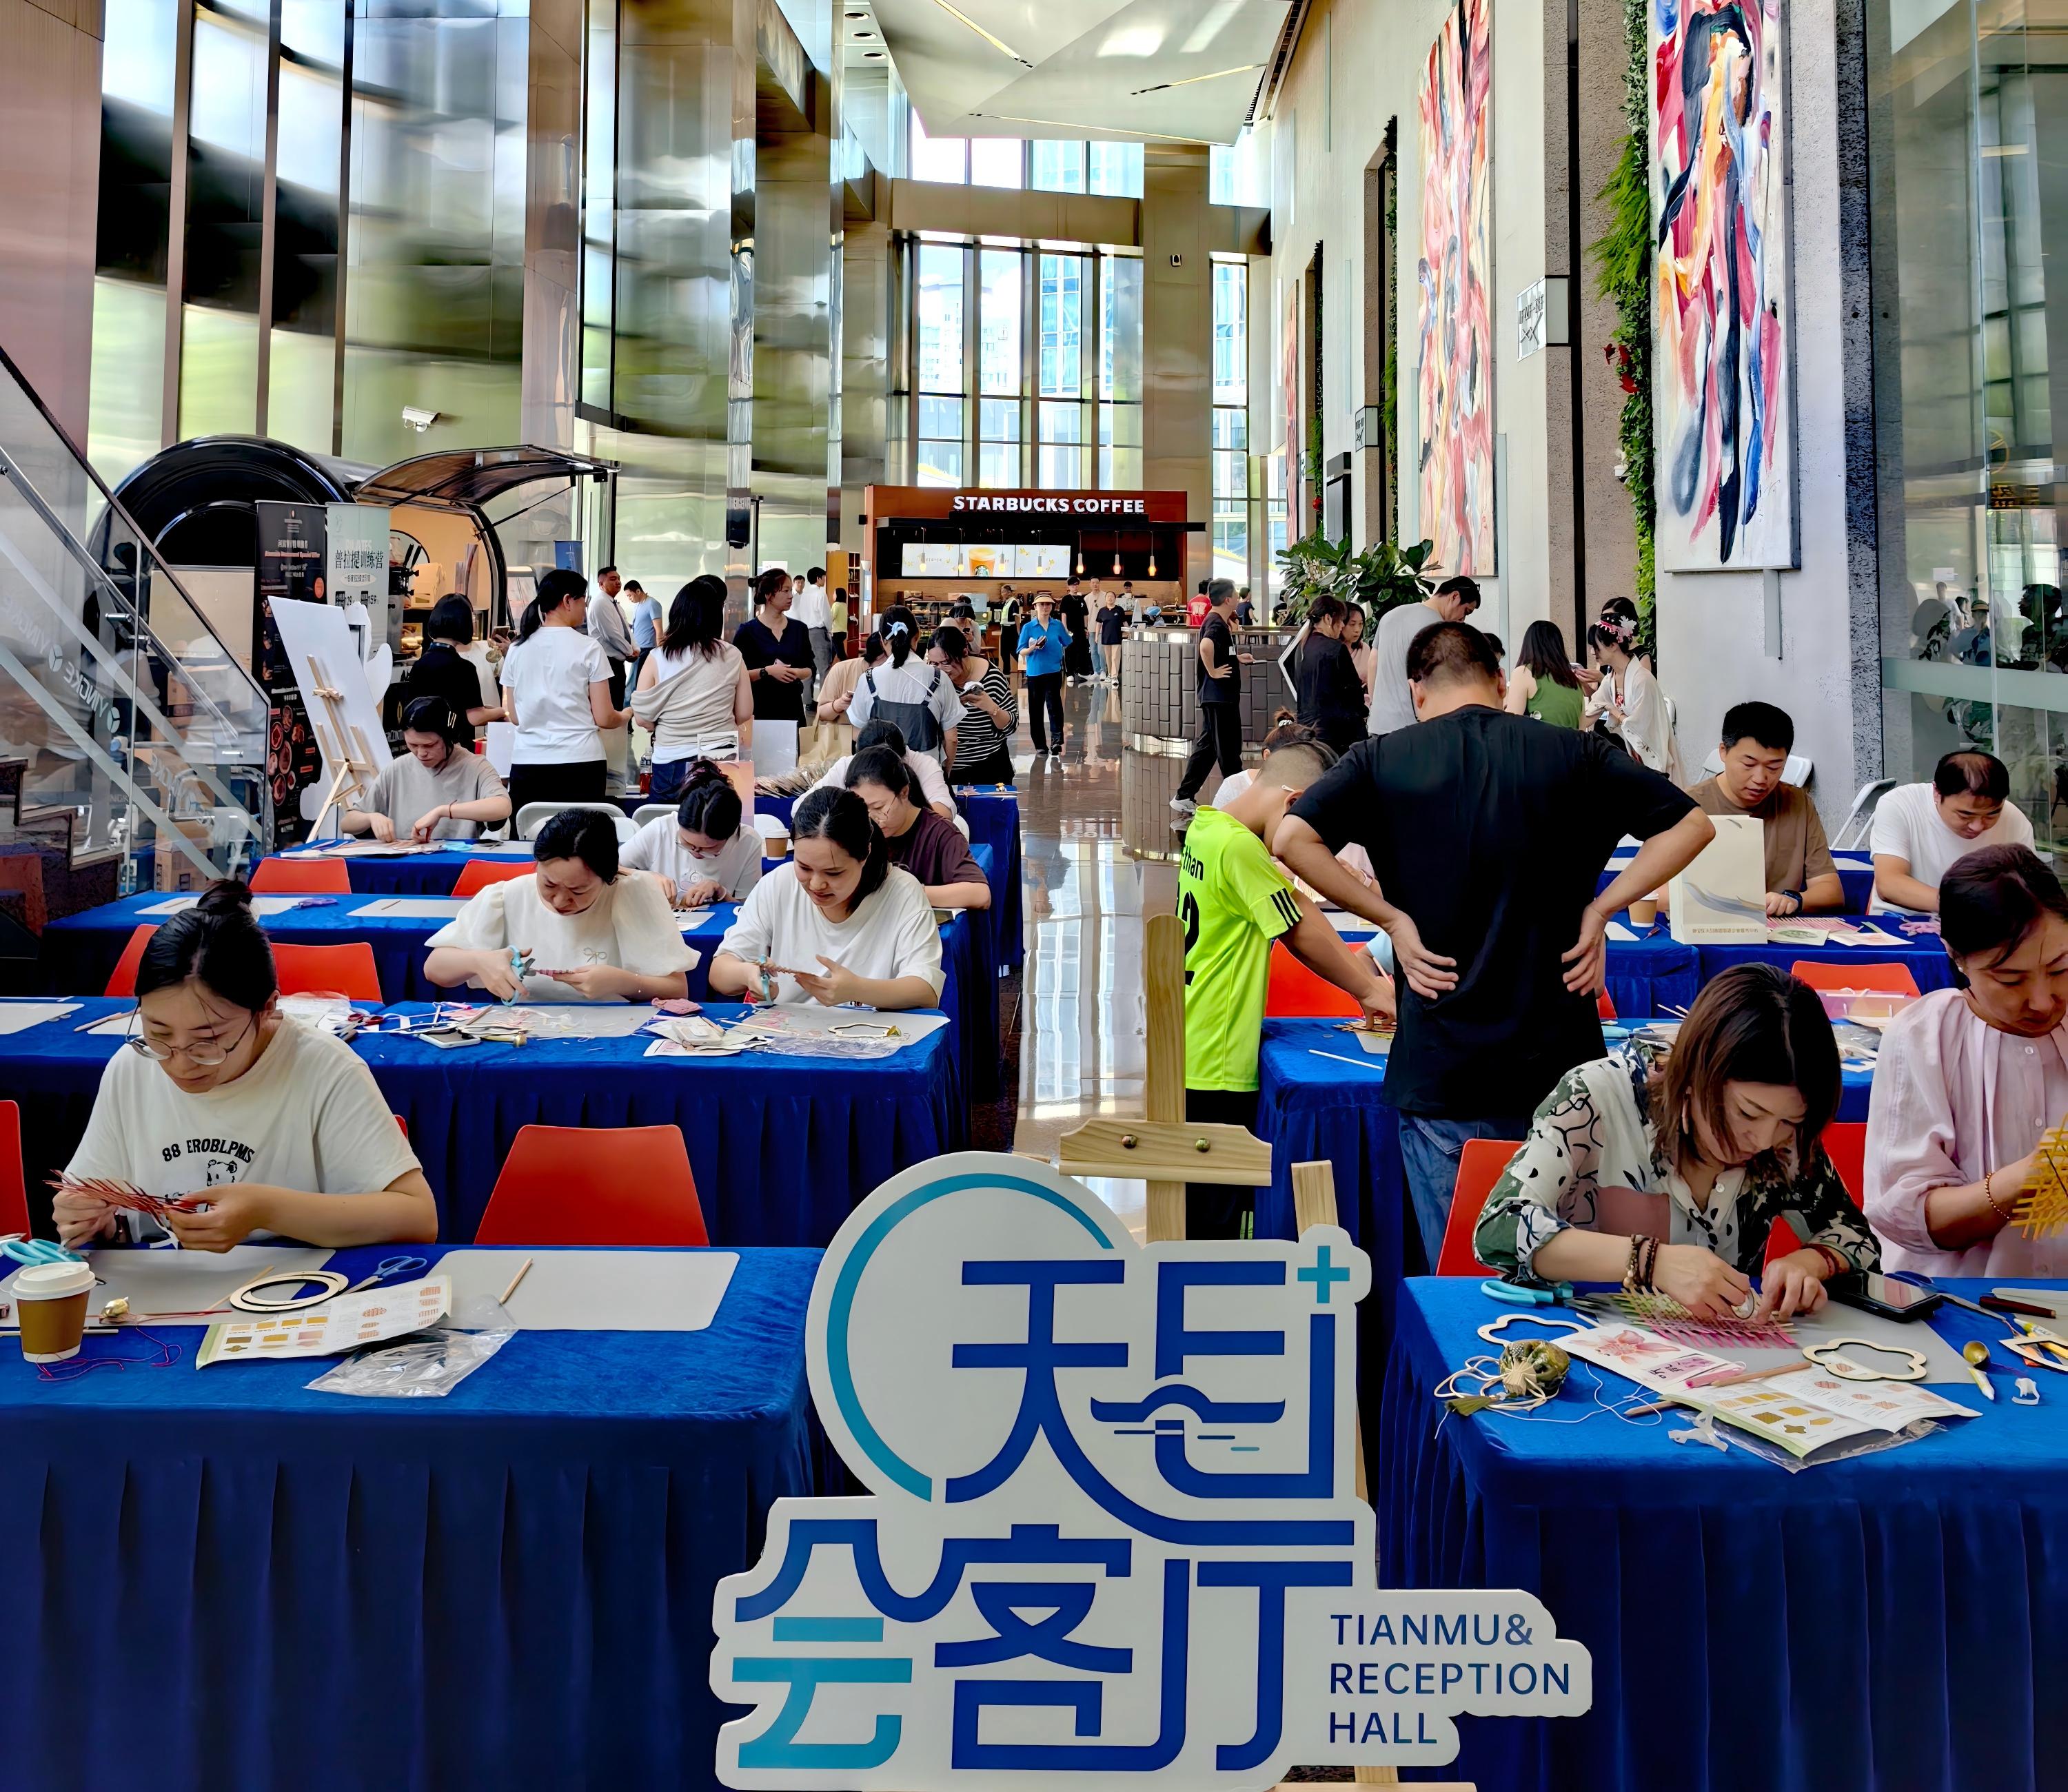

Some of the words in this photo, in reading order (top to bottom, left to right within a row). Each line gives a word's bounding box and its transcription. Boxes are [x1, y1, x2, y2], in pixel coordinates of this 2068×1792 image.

[953, 496, 1069, 513] STARBUCKS
[1073, 499, 1144, 513] COFFEE
[335, 549, 384, 569] 普拉提训练营
[162, 1143, 181, 1162] 88
[186, 1138, 256, 1163] EROBLPMS
[731, 1518, 1354, 1772] 会客厅
[1330, 1613, 1534, 1646] TIANMU&
[1330, 1662, 1570, 1696] RECEPTION
[1329, 1712, 1438, 1744] HALL
